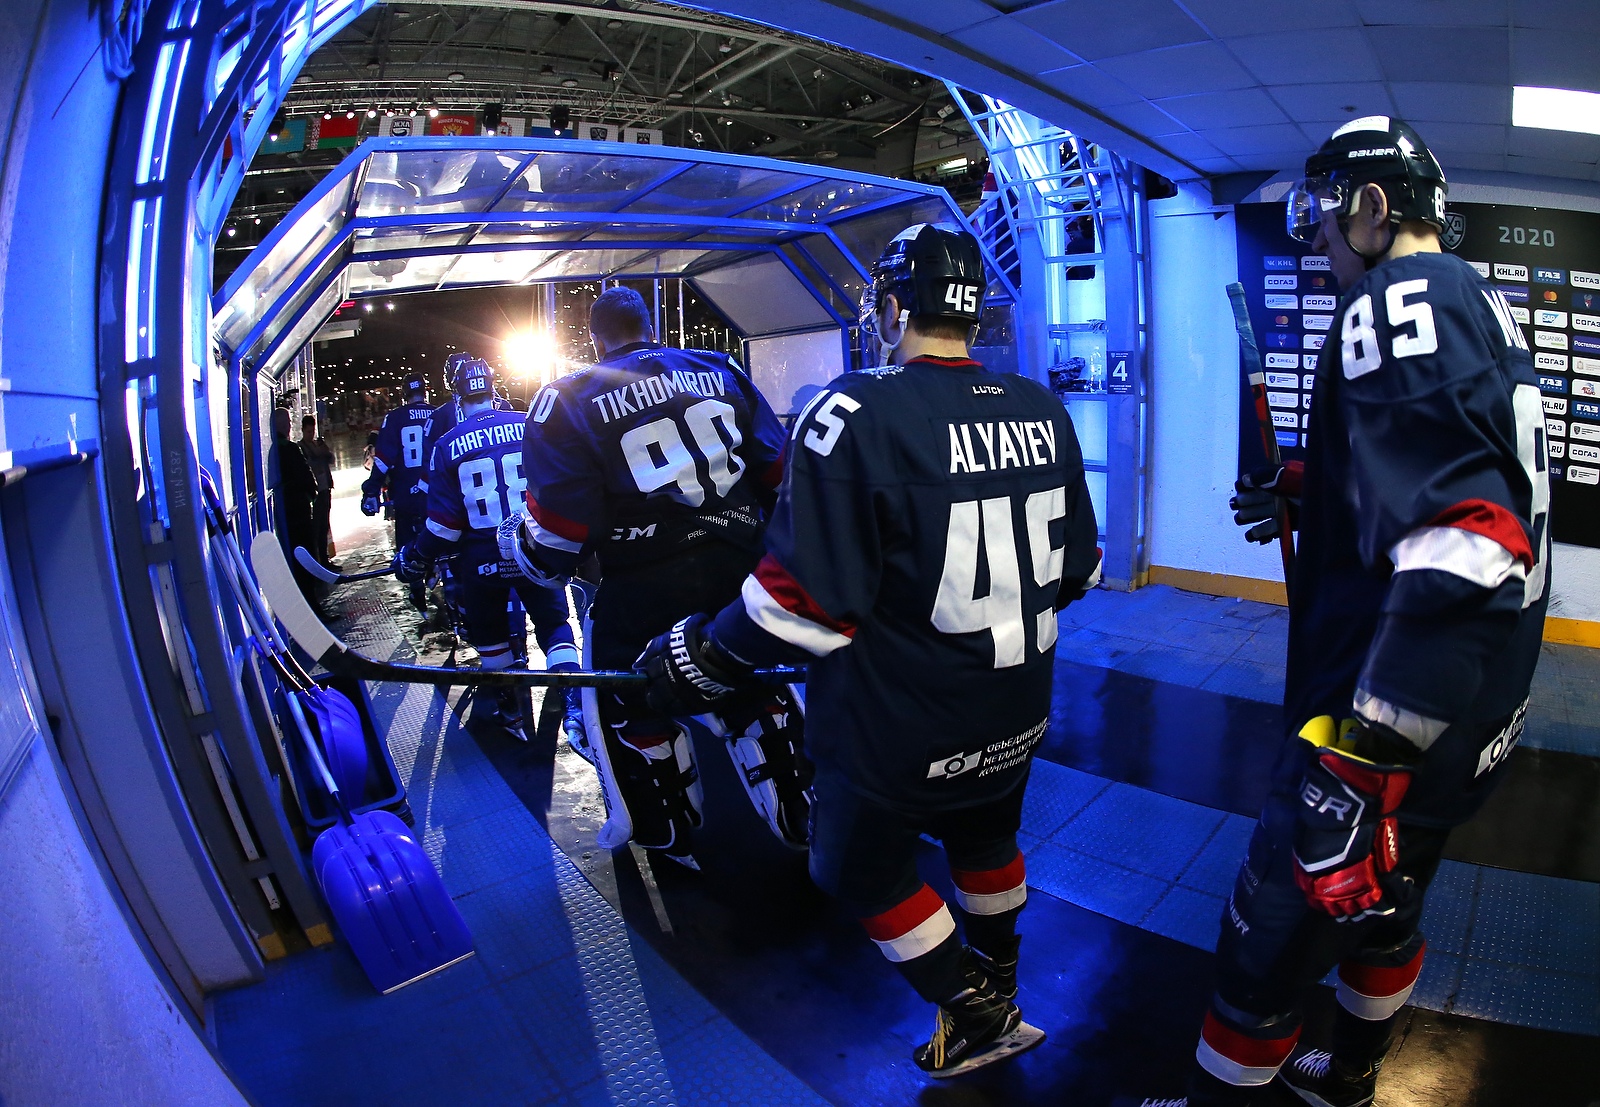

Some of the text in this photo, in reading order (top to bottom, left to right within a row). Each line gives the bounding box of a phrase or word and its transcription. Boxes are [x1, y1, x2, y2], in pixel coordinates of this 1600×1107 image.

[1348, 149, 1394, 158] BAUER
[1499, 226, 1555, 247] 2020
[1496, 267, 1526, 277] KHL.RU
[1538, 270, 1561, 279] ГАЗ
[1573, 276, 1600, 285] СОГАЗ
[945, 283, 978, 313] 45
[1341, 279, 1438, 380] 85
[1538, 357, 1565, 366] СОГАЗ
[1112, 360, 1128, 382] 4
[469, 377, 486, 391] 88
[1540, 377, 1563, 387] ГАЗ
[972, 385, 1005, 395] LUTCH
[592, 370, 725, 424] TIKHOMIROV
[1542, 400, 1565, 411] HL.RU
[1576, 403, 1599, 413] ГАЗ
[449, 421, 526, 461] ZHAFYARO
[949, 419, 1057, 474] ALYAYEV
[1572, 449, 1598, 458] СОГАЗ
[931, 486, 1066, 670] 45
[669, 616, 735, 694] WARRIOR
